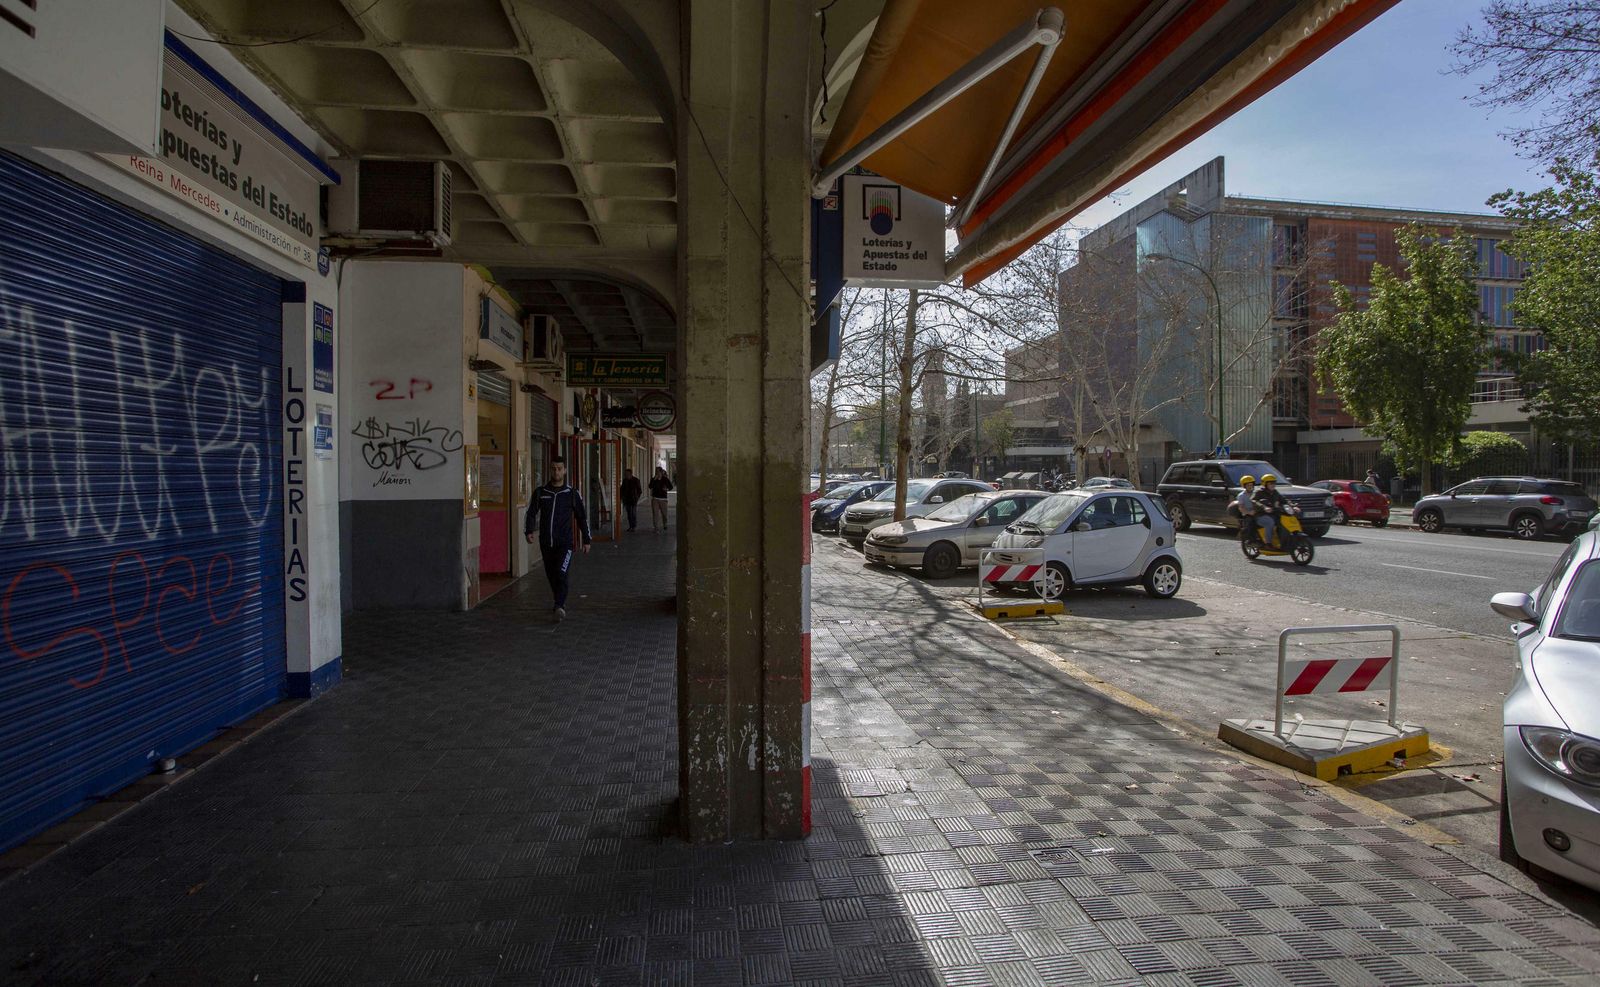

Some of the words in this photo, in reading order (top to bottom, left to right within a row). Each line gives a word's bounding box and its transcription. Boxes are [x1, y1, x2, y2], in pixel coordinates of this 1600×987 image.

[161, 88, 228, 150] oterías
[232, 139, 242, 166] y
[130, 155, 164, 182] Reina
[170, 174, 221, 214] Mercedes
[233, 211, 292, 253] Administración
[303, 249, 312, 263] 38
[159, 128, 238, 190] puestas
[242, 177, 266, 209] del
[269, 191, 314, 238] Estado
[863, 250, 909, 260] Apuestas
[913, 251, 927, 260] del
[863, 262, 897, 270] Estado
[906, 241, 912, 250] y
[286, 366, 307, 603] LOTERIAS
